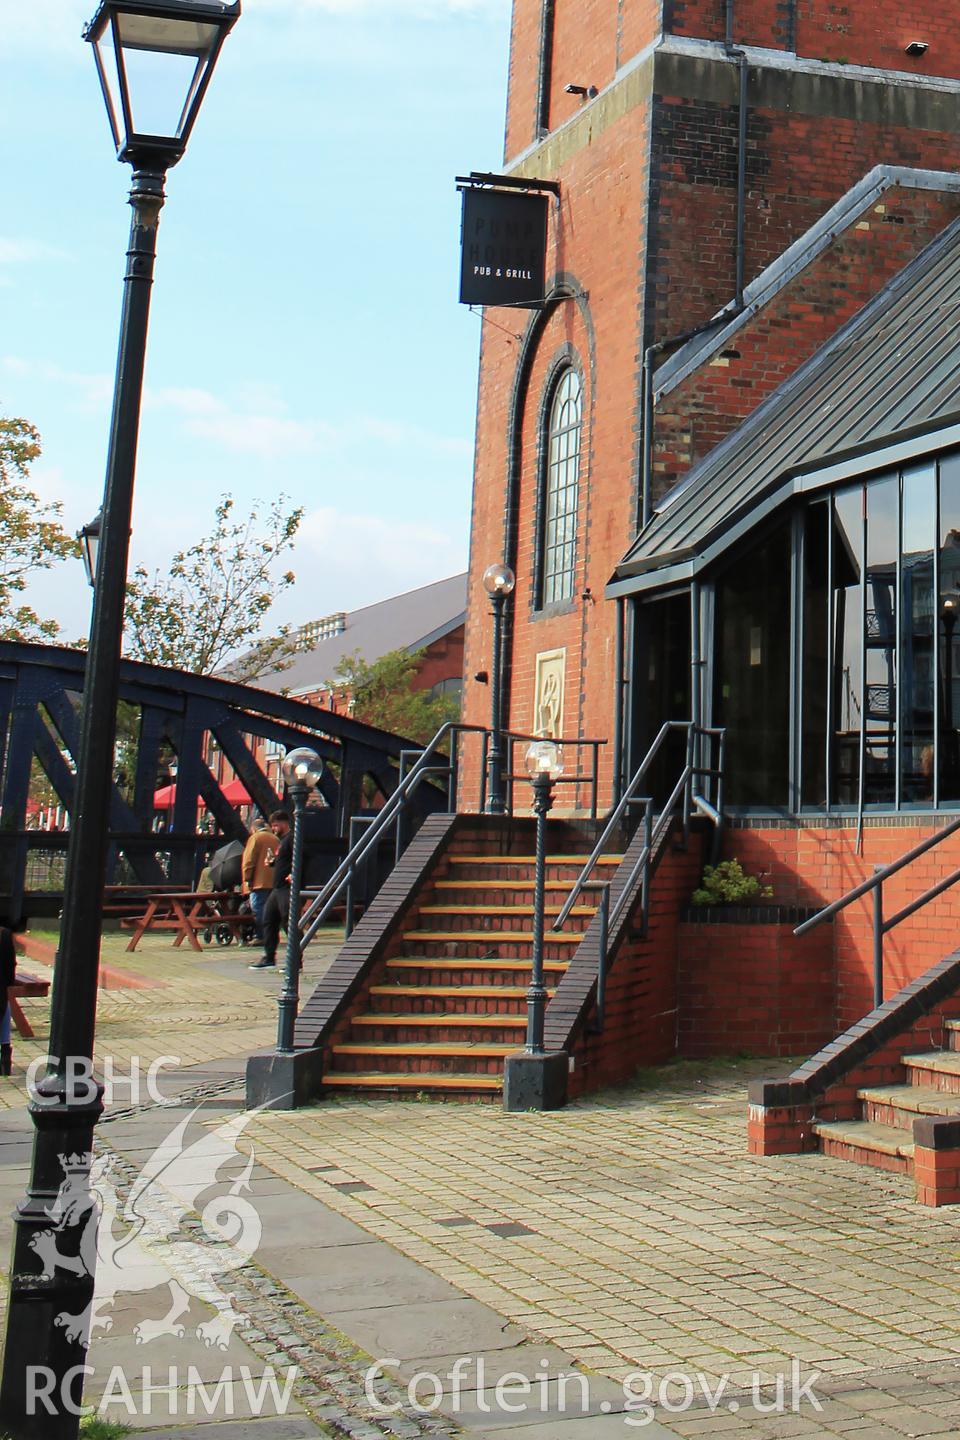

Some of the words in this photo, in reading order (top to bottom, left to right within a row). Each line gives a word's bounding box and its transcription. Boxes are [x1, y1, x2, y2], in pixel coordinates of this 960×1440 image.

[474, 266, 491, 276] PUB
[495, 267, 502, 277] &
[506, 268, 532, 279] GRILL
